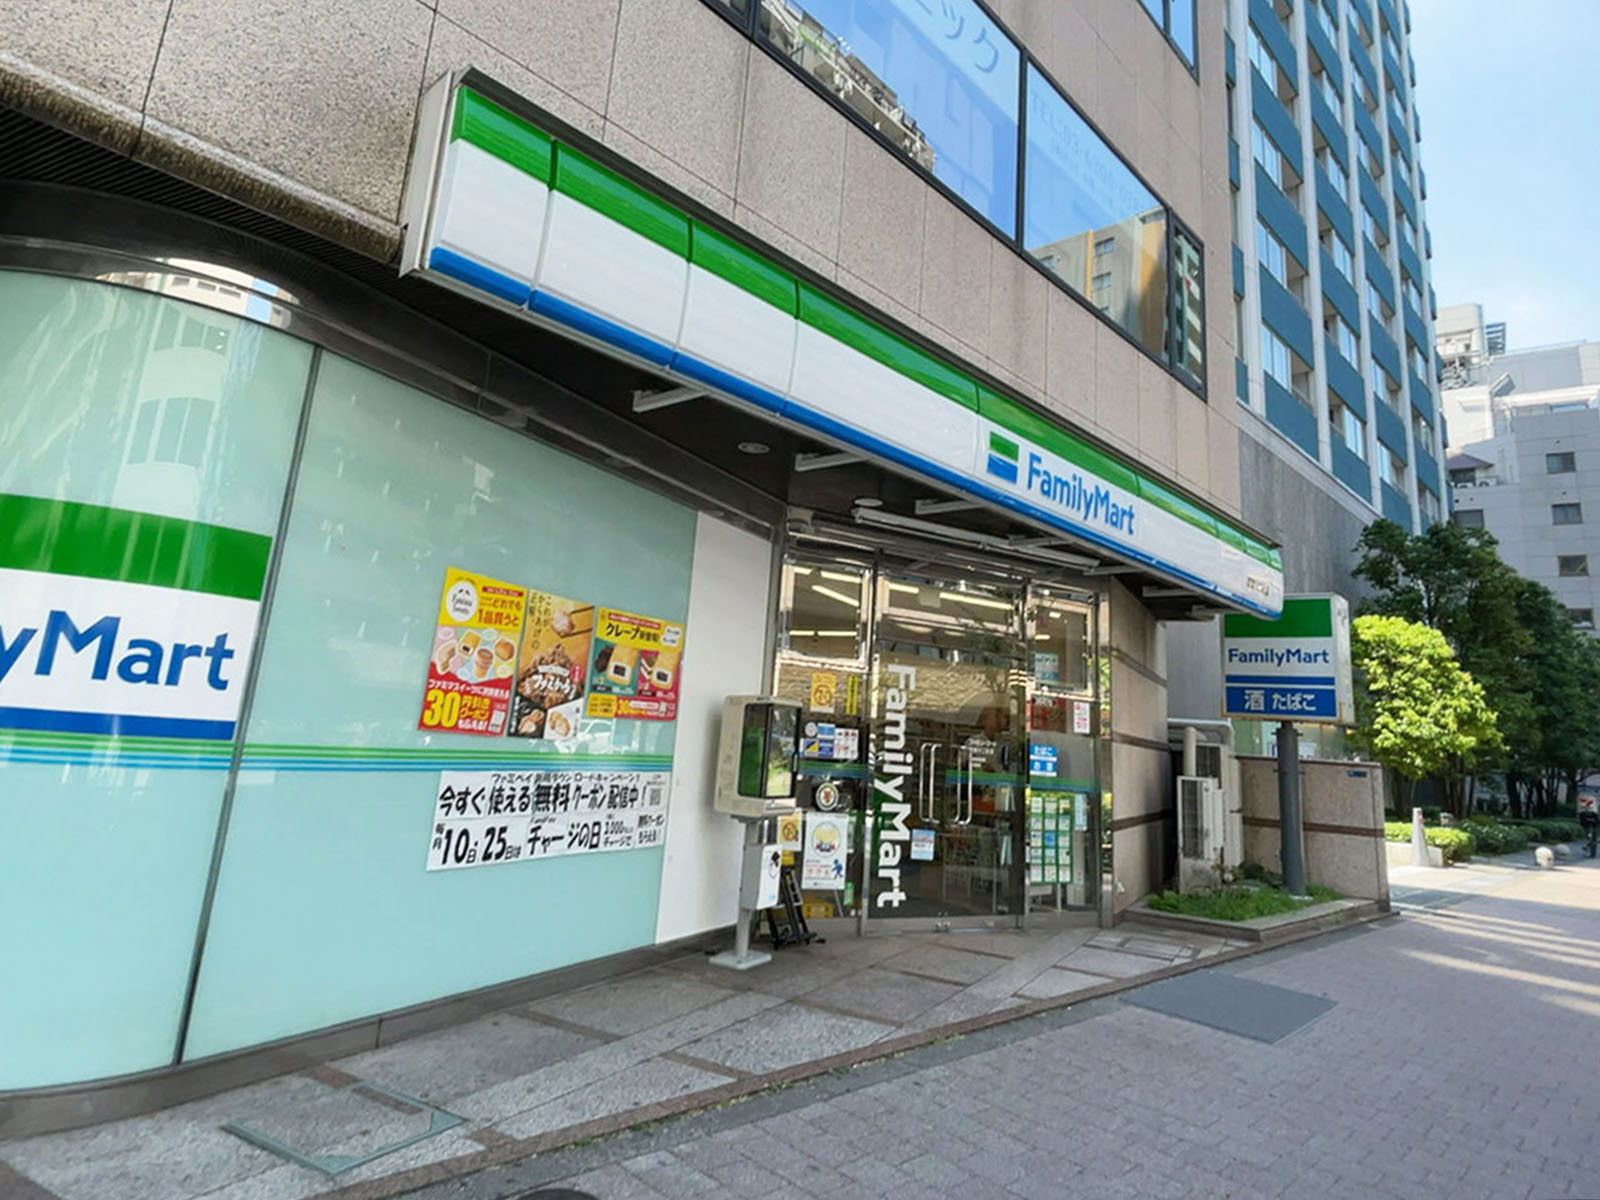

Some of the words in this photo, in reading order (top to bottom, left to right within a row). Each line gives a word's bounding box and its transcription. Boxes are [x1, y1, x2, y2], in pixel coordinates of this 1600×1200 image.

[1027, 452, 1135, 535] FamilyMart
[1228, 648, 1329, 667] FamilyMart
[423, 689, 460, 728] 30
[1244, 690, 1265, 711] 酒
[1272, 693, 1316, 711] たばこ
[874, 664, 916, 908] FamilyMart
[527, 820, 602, 855] チャージの日
